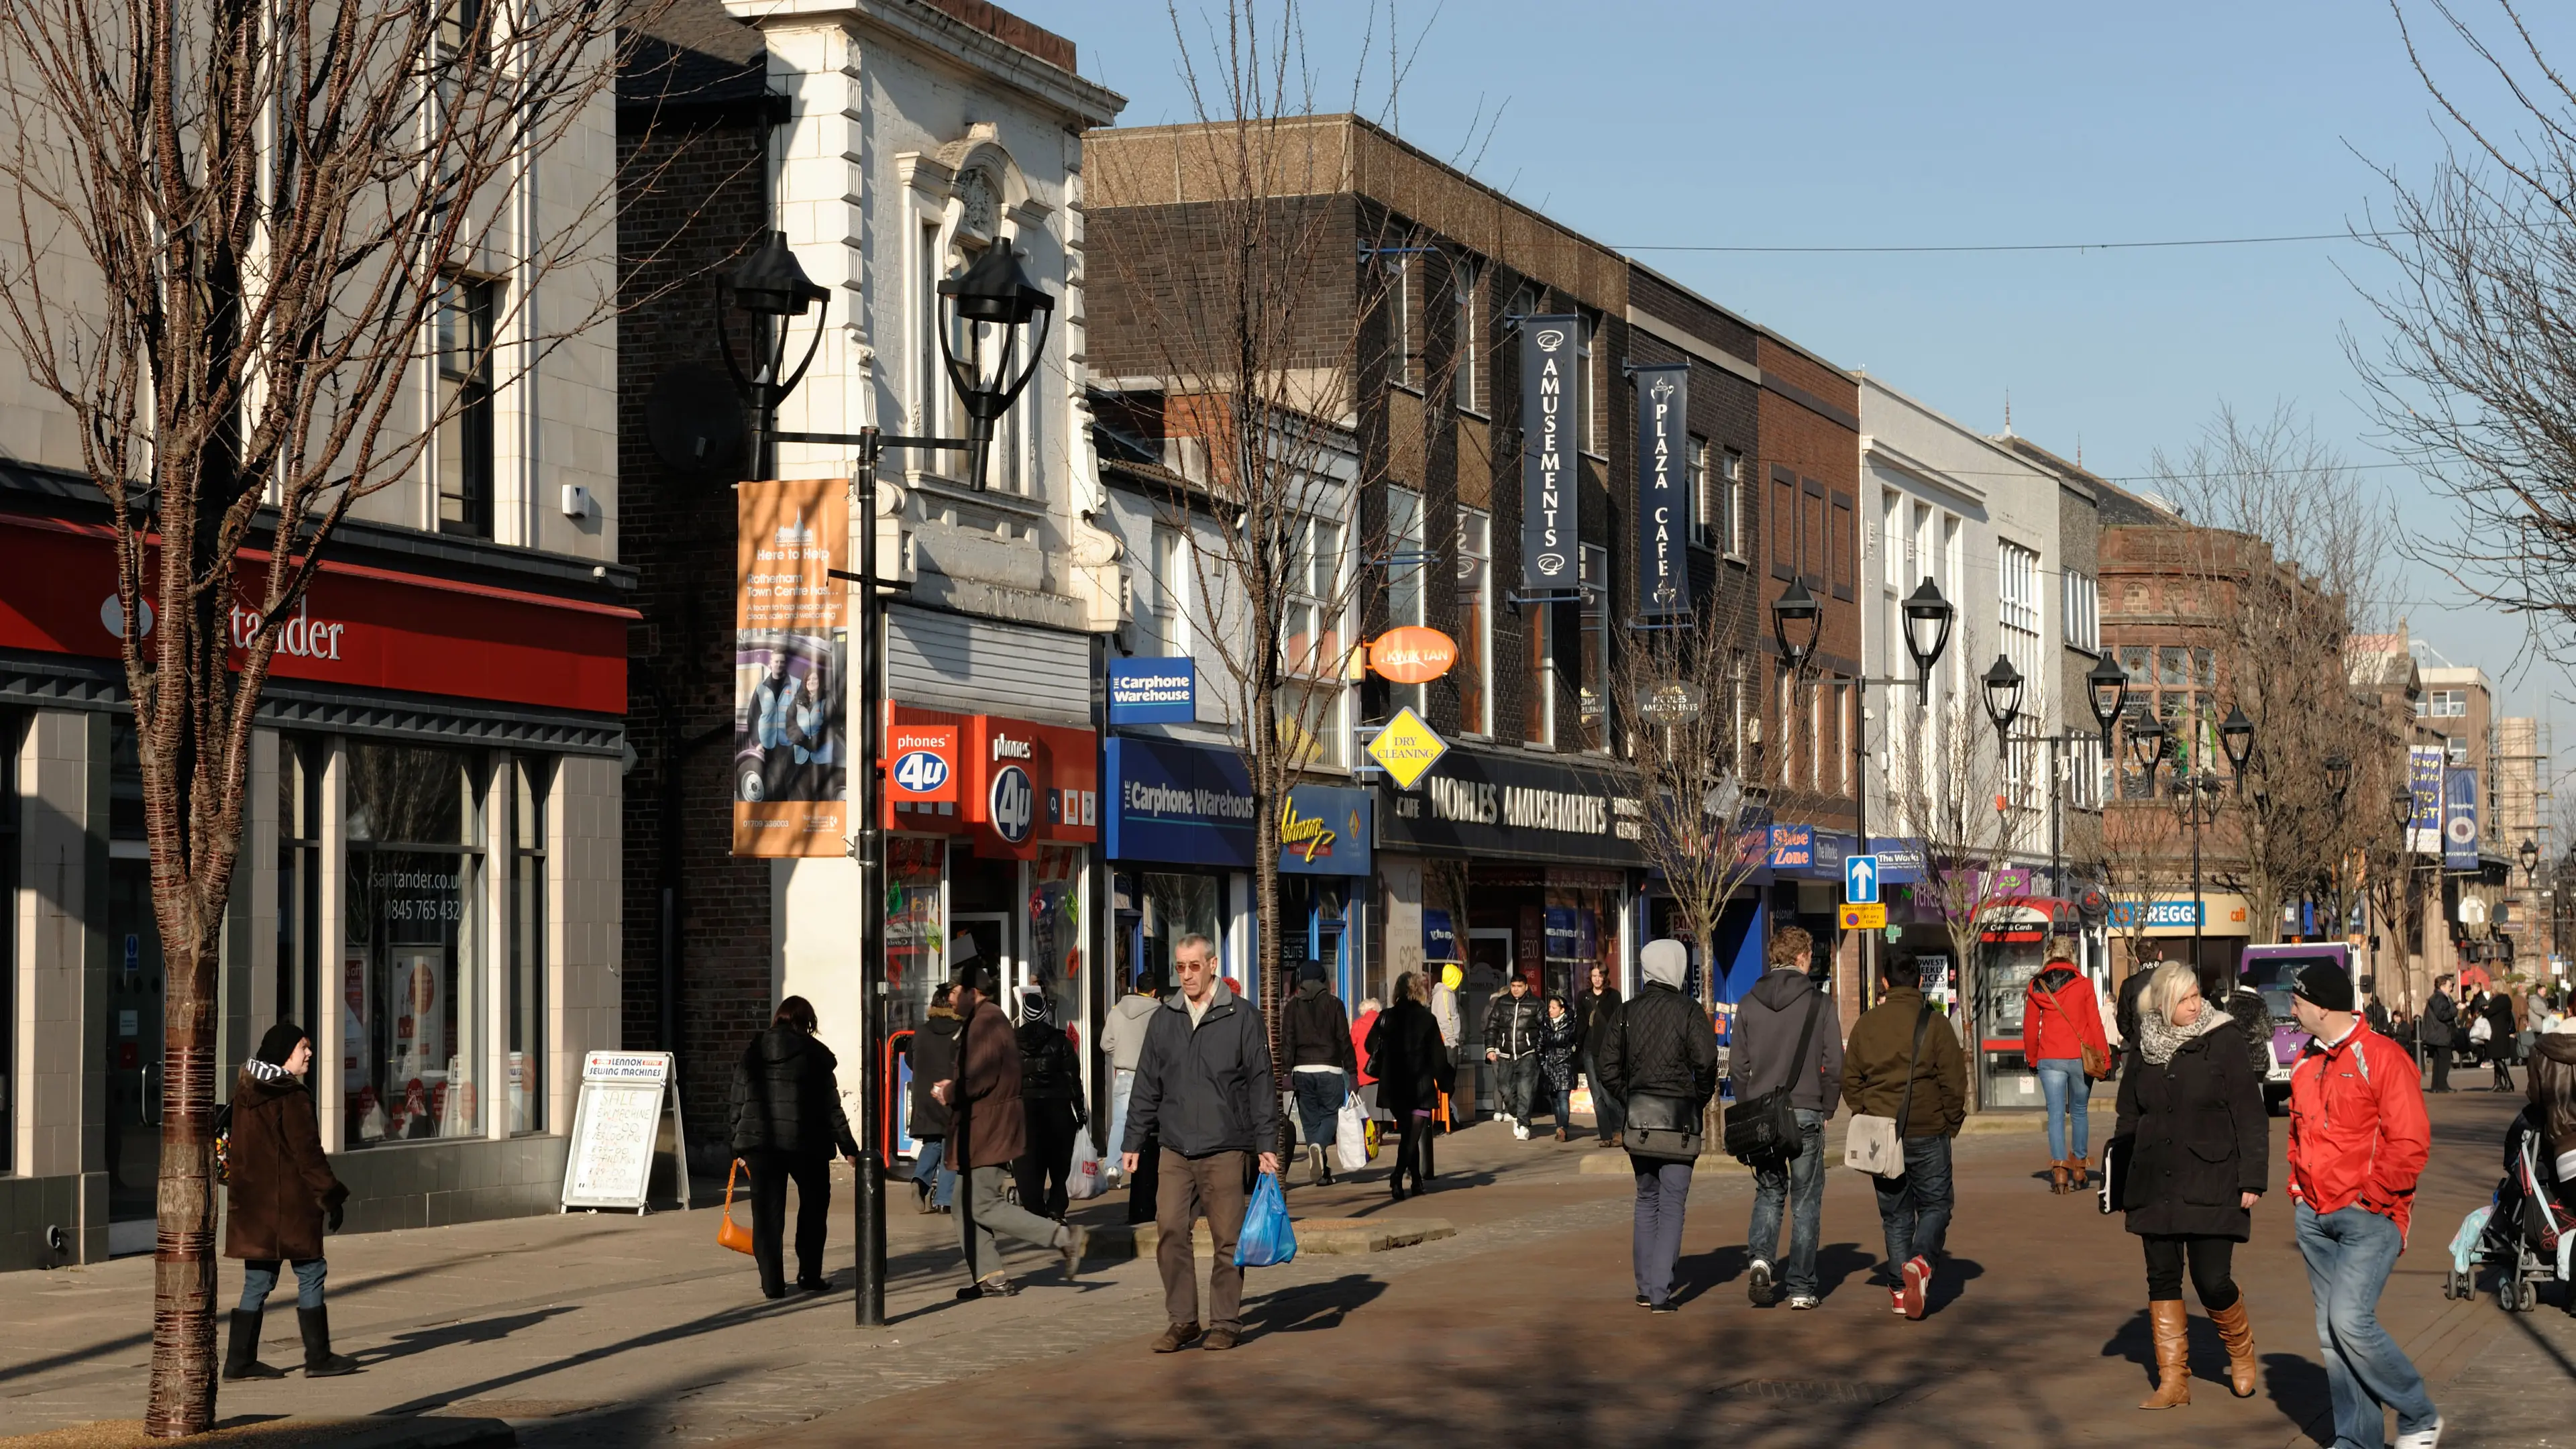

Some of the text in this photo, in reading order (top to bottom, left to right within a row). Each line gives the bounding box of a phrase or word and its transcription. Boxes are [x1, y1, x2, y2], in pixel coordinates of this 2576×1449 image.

[1541, 358, 1560, 547] AMUSEMENTS
[1655, 404, 1668, 489] PLAZA
[1655, 507, 1668, 576] CAFE
[757, 548, 830, 561] Here to Help
[747, 574, 803, 584] Rotherham
[747, 586, 771, 596] Town
[774, 586, 808, 596] Centre
[780, 604, 795, 612] help
[800, 611, 836, 621] welcoming
[1423, 649, 1448, 661] TAN
[1120, 676, 1190, 690] Carphone
[1114, 690, 1190, 702] Warehouse
[1642, 704, 1699, 712] AMUSMENTS
[898, 735, 945, 750] phones
[993, 733, 1032, 761] phones
[1395, 737, 1417, 746] DRY
[1377, 749, 1434, 759] CLEANING
[899, 754, 943, 790] 4u
[999, 771, 1032, 837] 4u
[1132, 782, 1193, 817] Carphone
[1194, 788, 1255, 818] Warehous
[1396, 796, 1419, 818] CAFE
[1432, 776, 1607, 835] NOBLES AMUSEMENTS
[1773, 828, 1809, 846] Shoe
[1773, 847, 1809, 865] Zone
[1816, 842, 1838, 860] The Works
[1878, 855, 1893, 863] The
[384, 900, 412, 920] 0845
[416, 900, 437, 920] 765
[1283, 946, 1303, 958] SUITS
[351, 963, 363, 977] off
[1922, 974, 1945, 982] ICES
[612, 1058, 643, 1066] LENNOX
[589, 1067, 661, 1077] SEWING MACHINES
[600, 1091, 638, 1106] SALE
